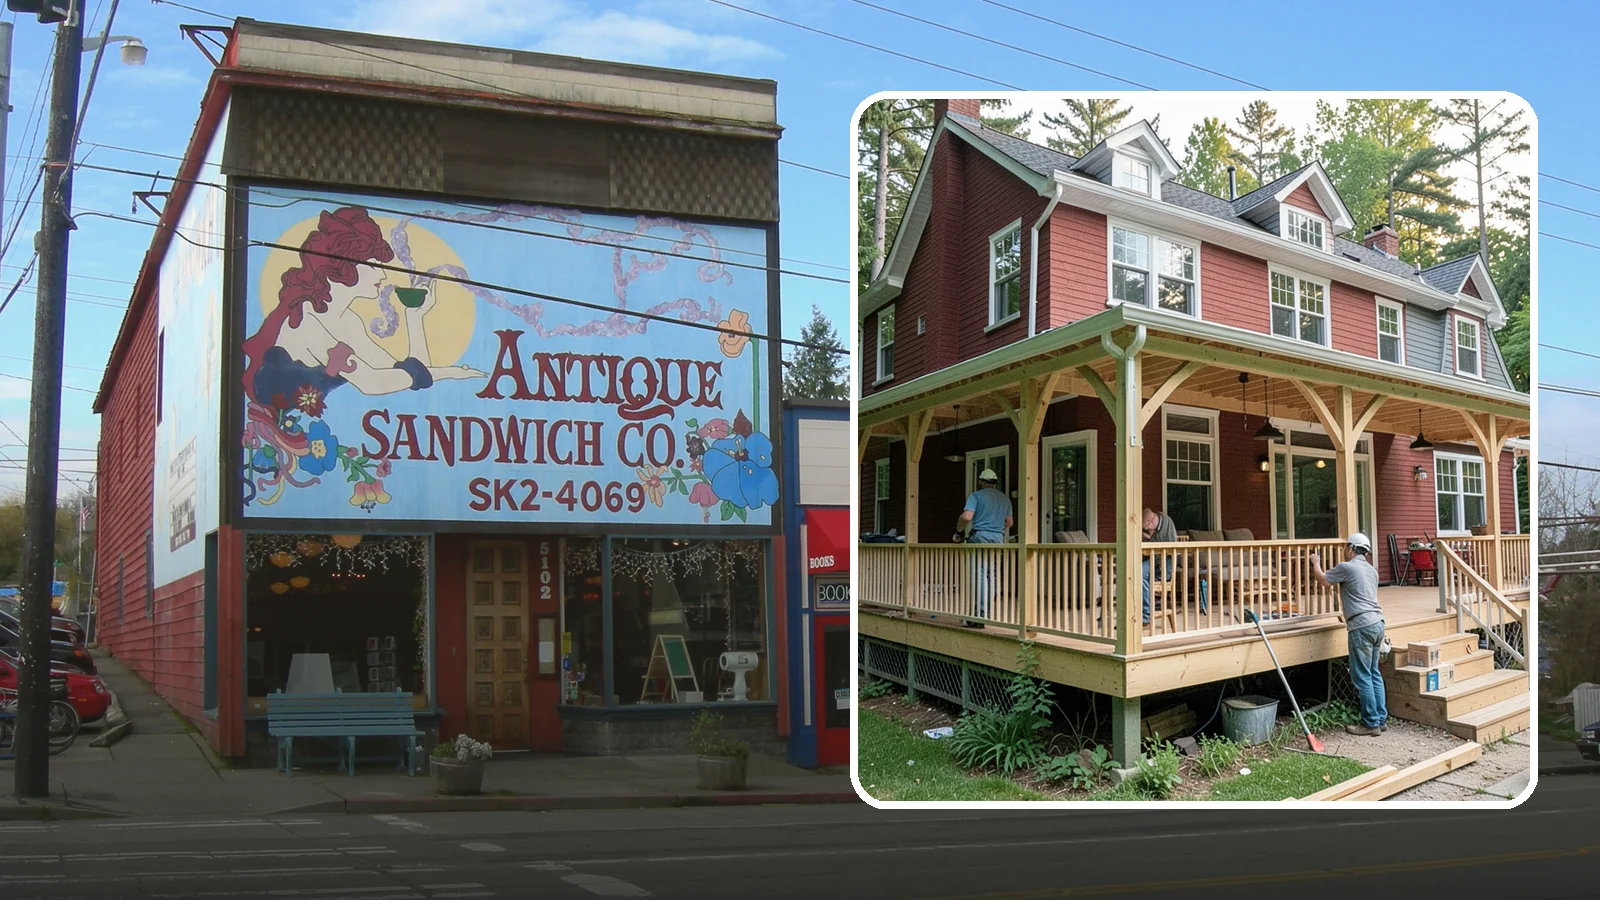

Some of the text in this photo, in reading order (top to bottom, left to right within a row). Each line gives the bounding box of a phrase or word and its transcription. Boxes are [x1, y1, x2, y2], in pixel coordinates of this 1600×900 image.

[476, 329, 723, 420] ANTIQUE
[361, 409, 684, 468] SANDWICH CO.
[469, 477, 646, 513] SK2-4069
[540, 541, 551, 600] 5102
[809, 555, 835, 569] BOOKS
